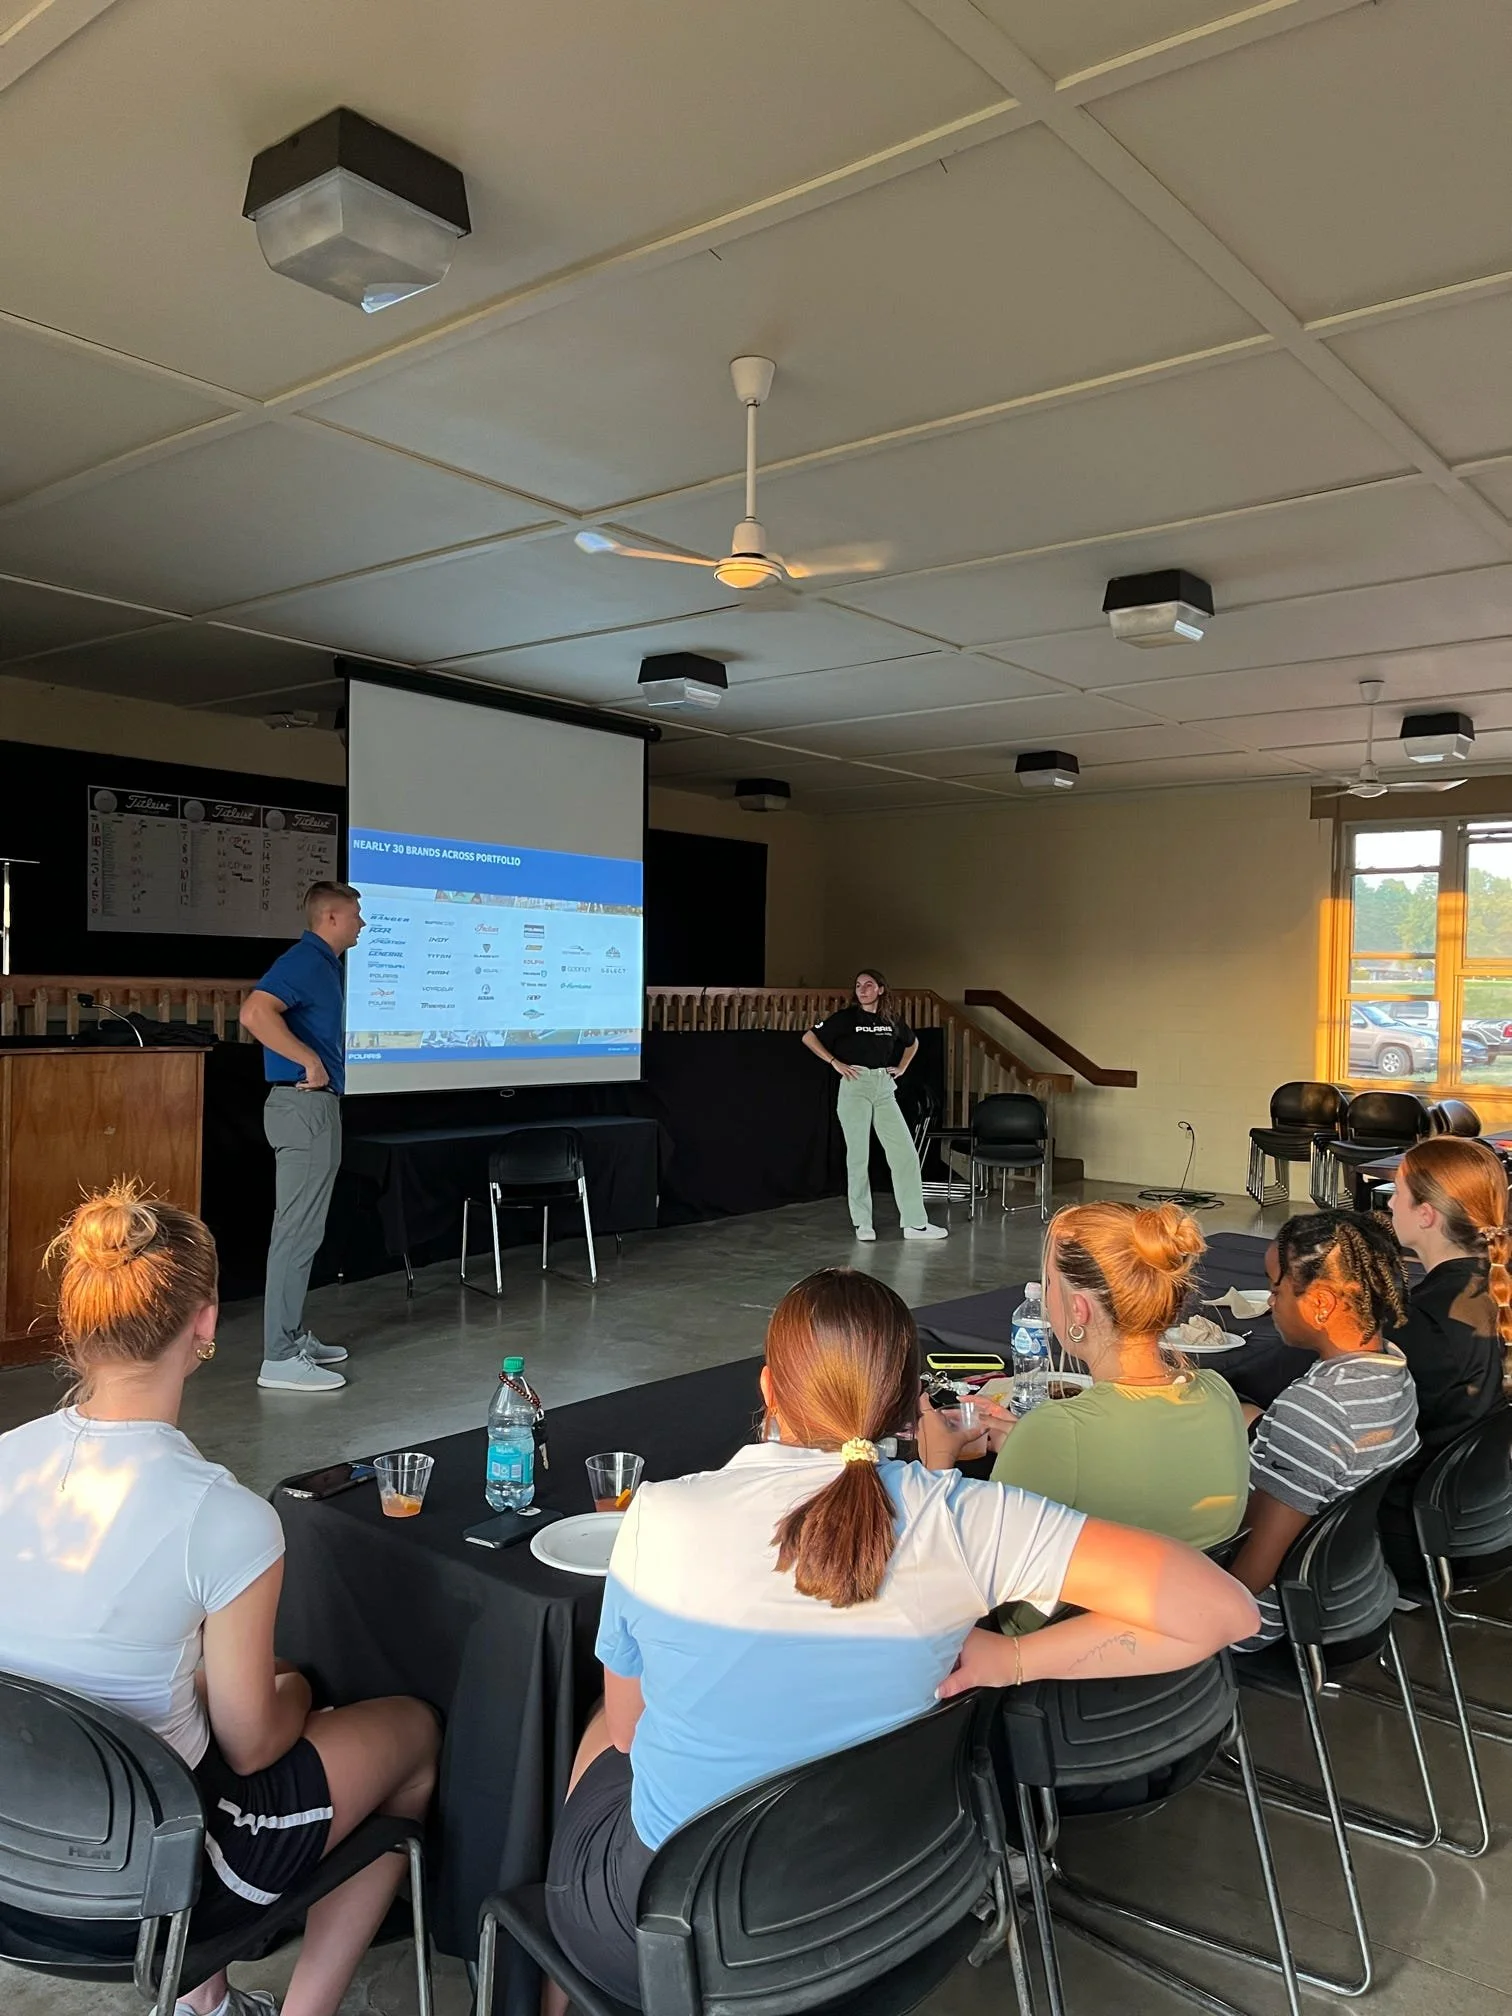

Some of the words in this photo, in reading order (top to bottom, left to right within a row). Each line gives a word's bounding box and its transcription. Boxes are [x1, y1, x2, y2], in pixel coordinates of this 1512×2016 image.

[126, 795, 171, 812] Titleist
[212, 804, 254, 820] Titleist
[292, 814, 331, 829] Titleist
[353, 840, 391, 853] NEARLY
[392, 844, 405, 854] 30
[406, 846, 440, 858] BRANDS
[442, 849, 475, 861] ACROSS
[475, 853, 521, 867] PORTFOLIO
[180, 869, 188, 881] 10
[262, 864, 271, 874] 15
[368, 950, 404, 958] GENERAL
